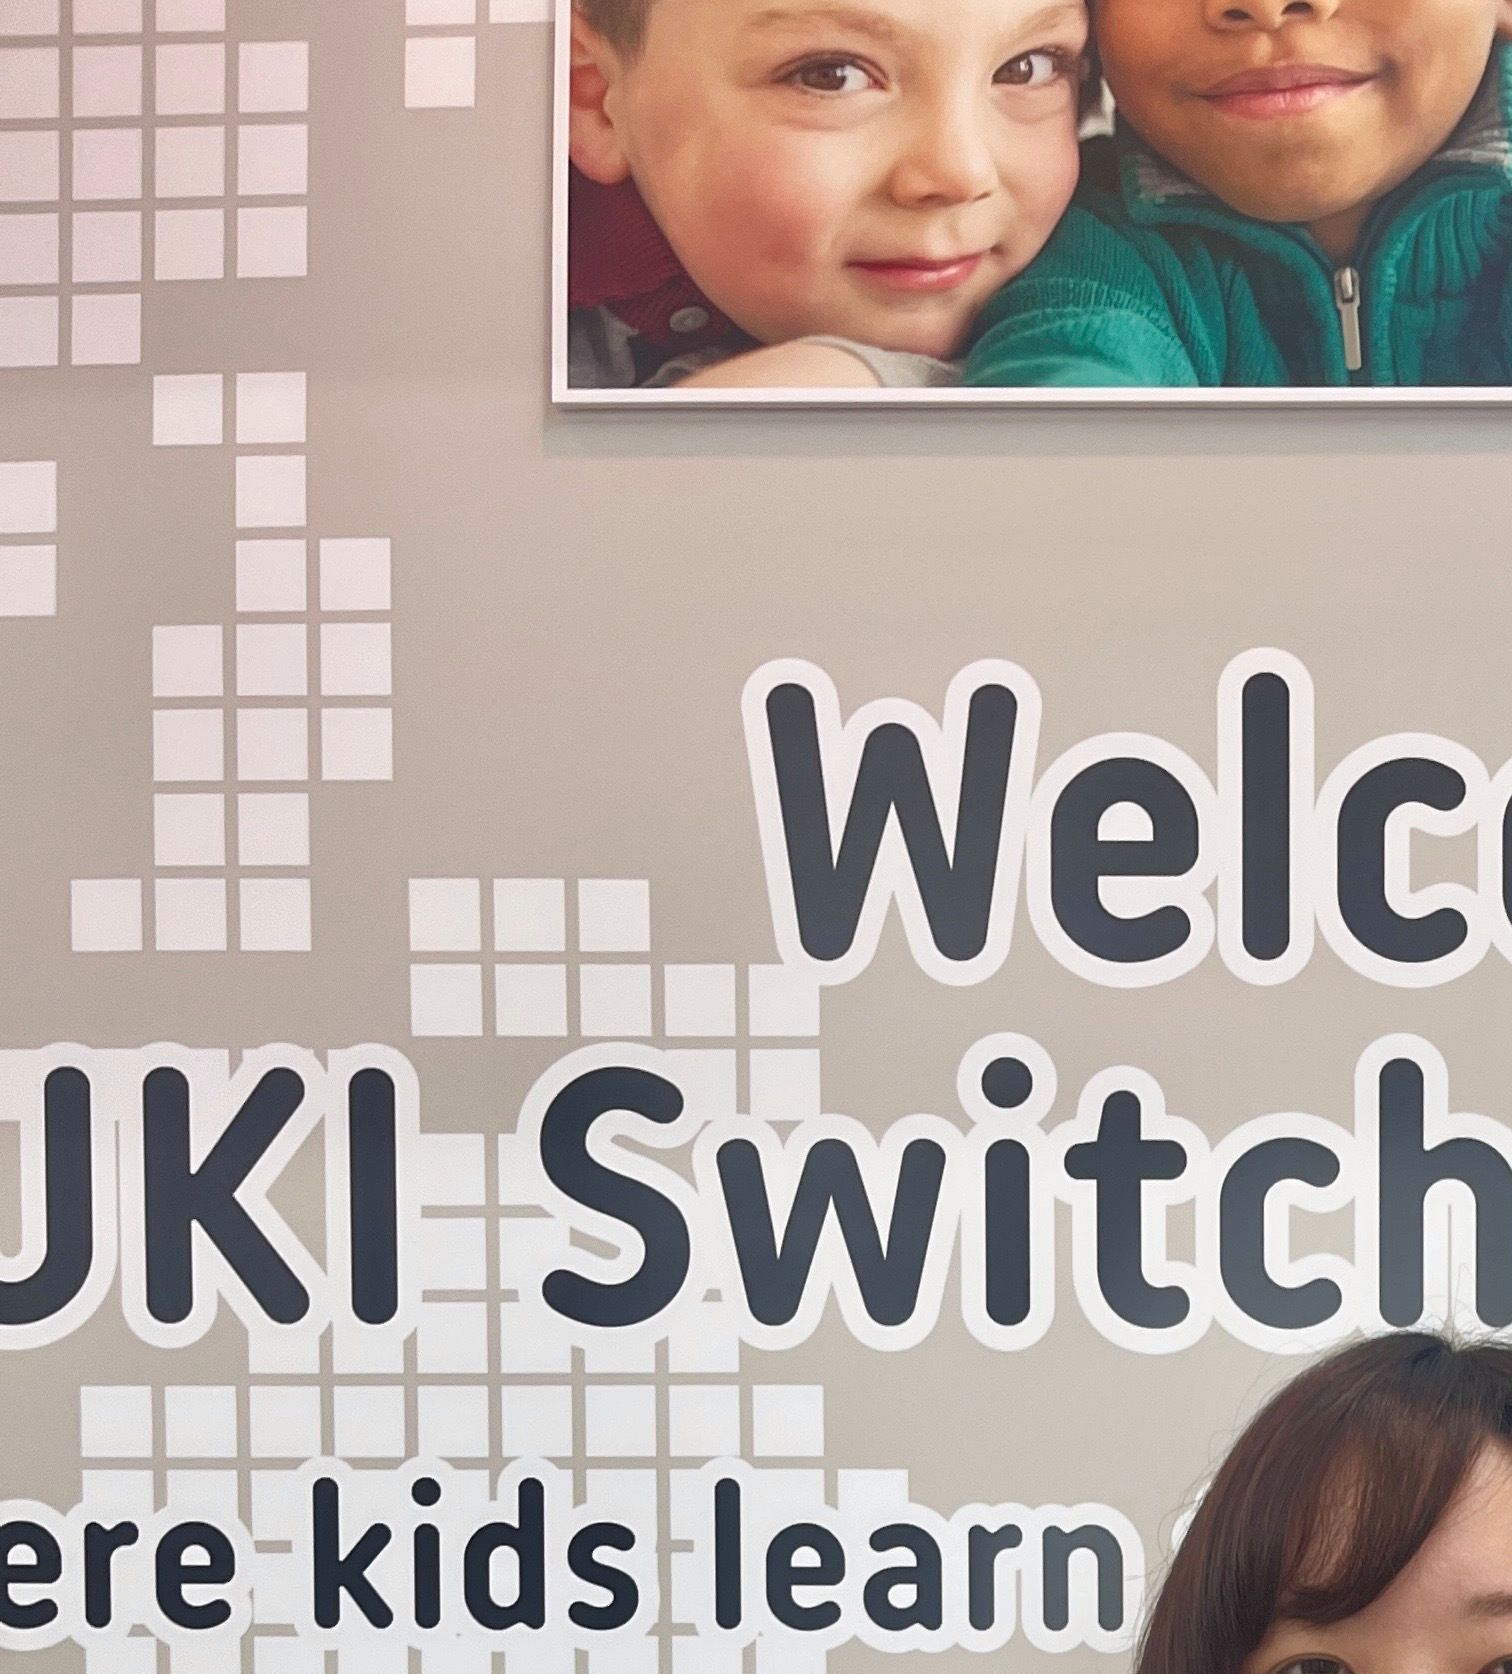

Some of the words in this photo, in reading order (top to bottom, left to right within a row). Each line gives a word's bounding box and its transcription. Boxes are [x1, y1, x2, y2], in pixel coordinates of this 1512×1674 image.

[0, 1521, 235, 1630] ere
[313, 1478, 638, 1630] kids
[715, 1478, 1123, 1631] learn
